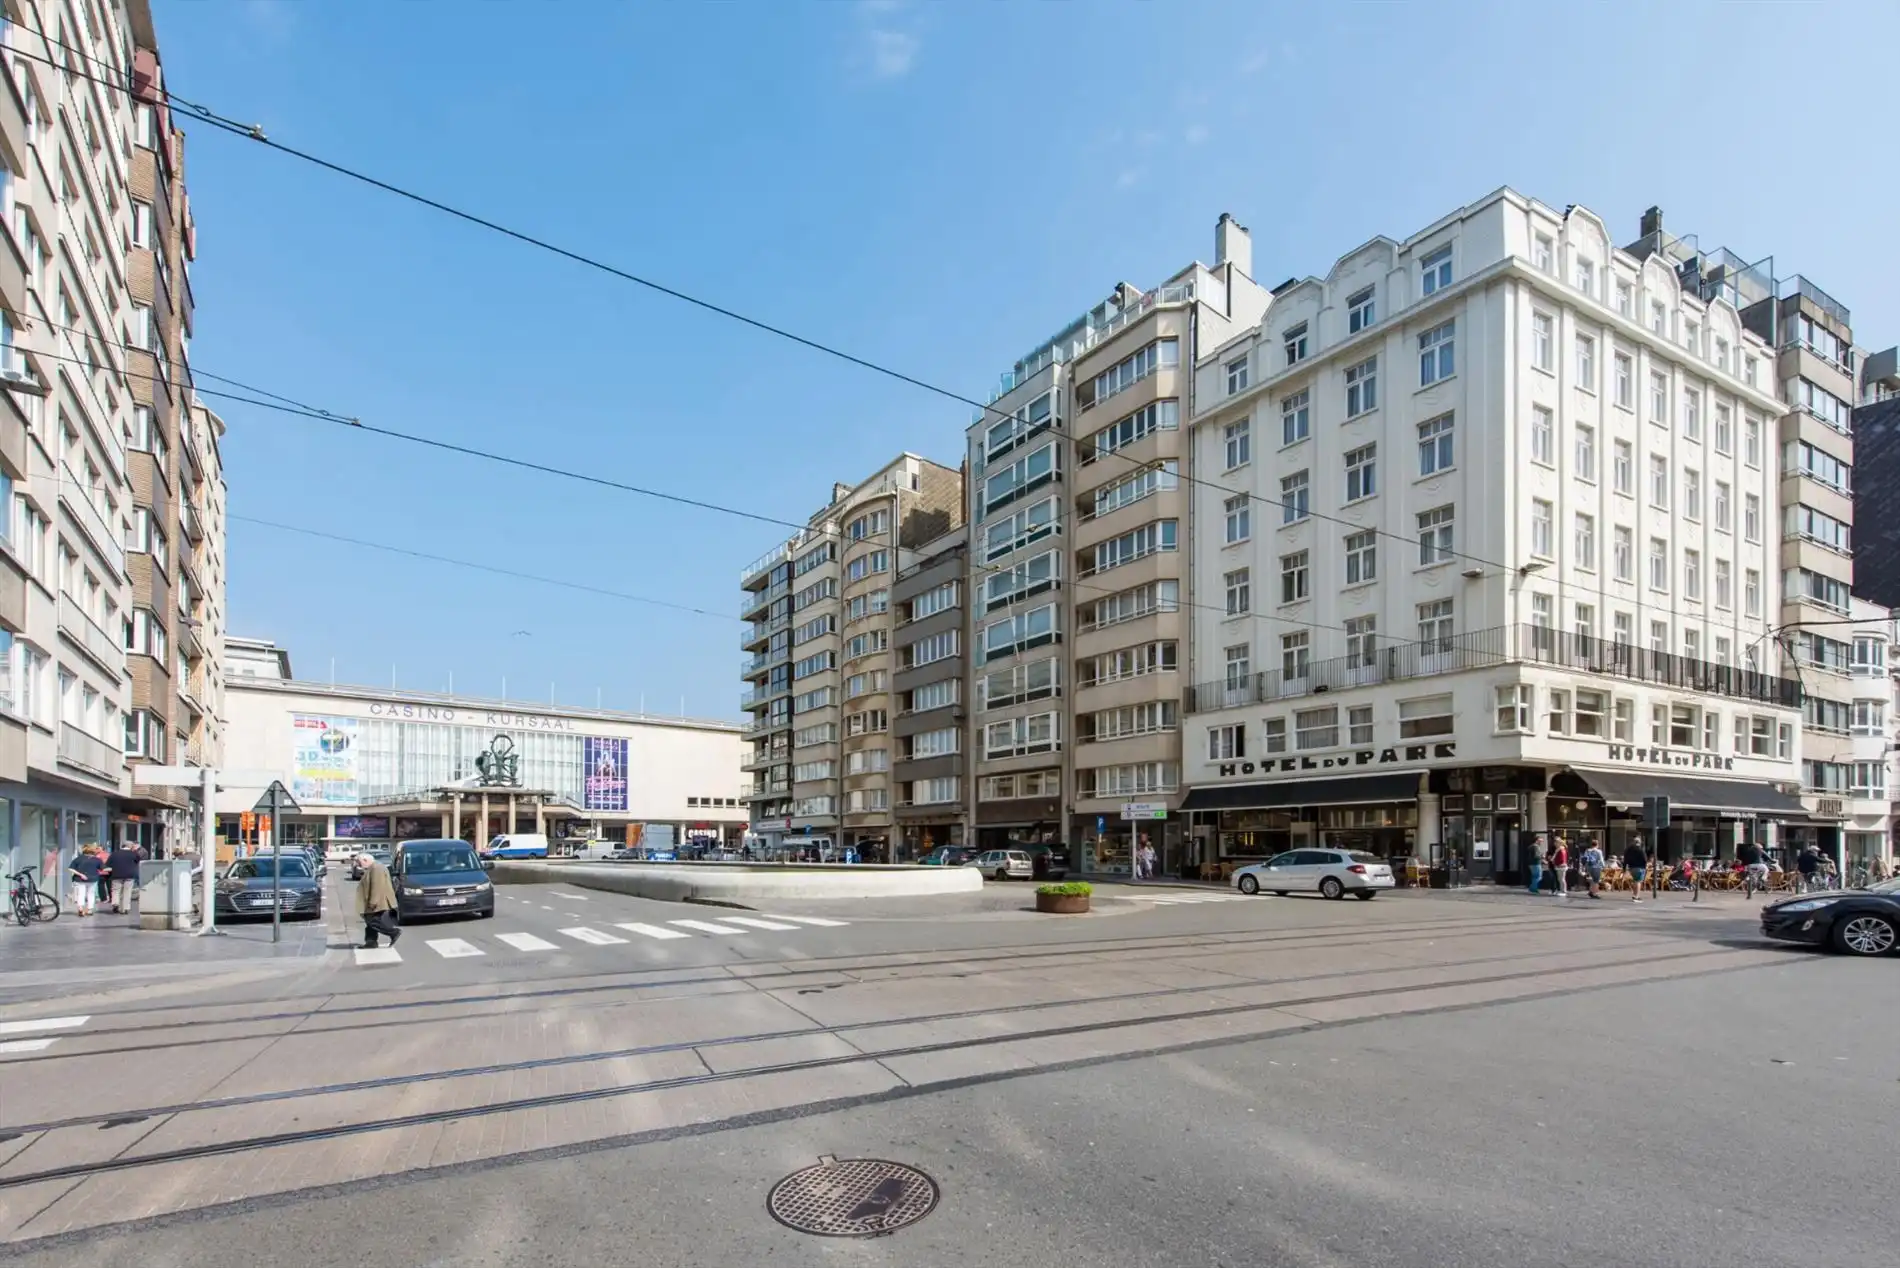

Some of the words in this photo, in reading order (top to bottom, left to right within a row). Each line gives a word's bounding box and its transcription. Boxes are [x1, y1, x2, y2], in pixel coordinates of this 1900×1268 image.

[370, 703, 455, 721] CASINO
[486, 712, 575, 730] KURSAAL
[1608, 743, 1671, 764] HOTEL
[1675, 756, 1689, 766] DU
[1219, 756, 1317, 777] HOTEL
[1323, 756, 1349, 768] DU
